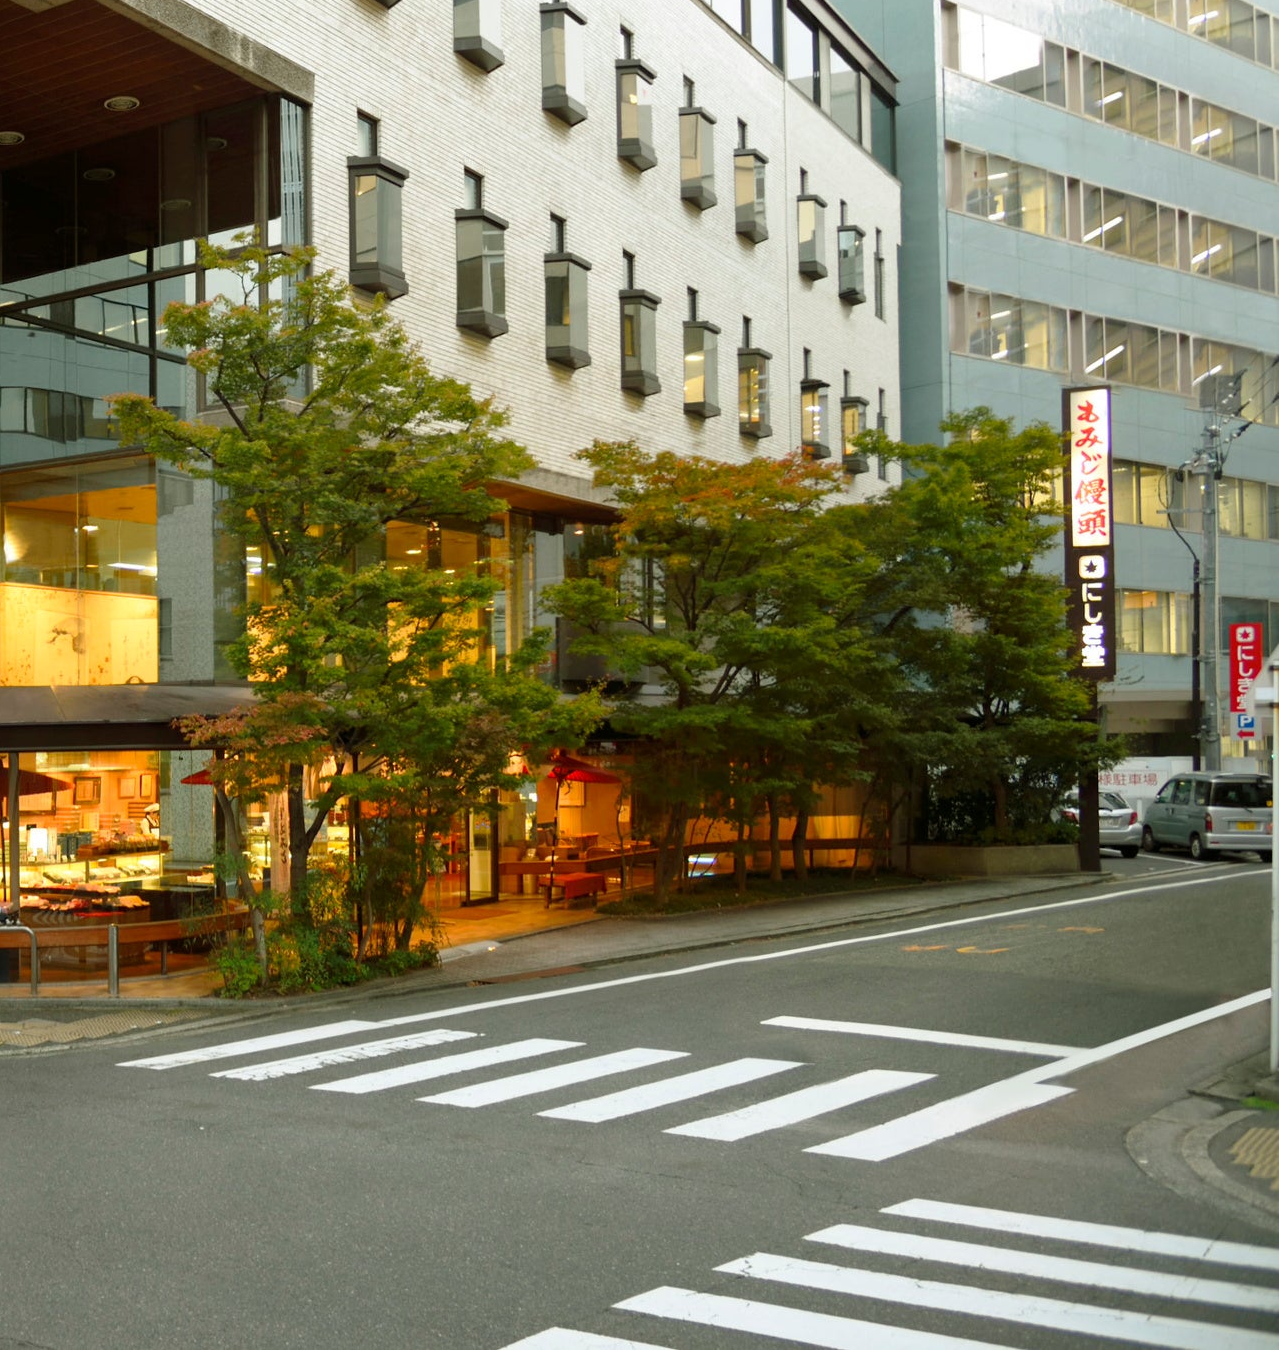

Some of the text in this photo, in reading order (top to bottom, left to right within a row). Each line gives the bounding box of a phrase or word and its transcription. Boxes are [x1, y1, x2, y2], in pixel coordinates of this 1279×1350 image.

[1075, 400, 1107, 536] もみじ饅頭
[1081, 583, 1105, 667] にしき堂
[1241, 715, 1252, 727] P
